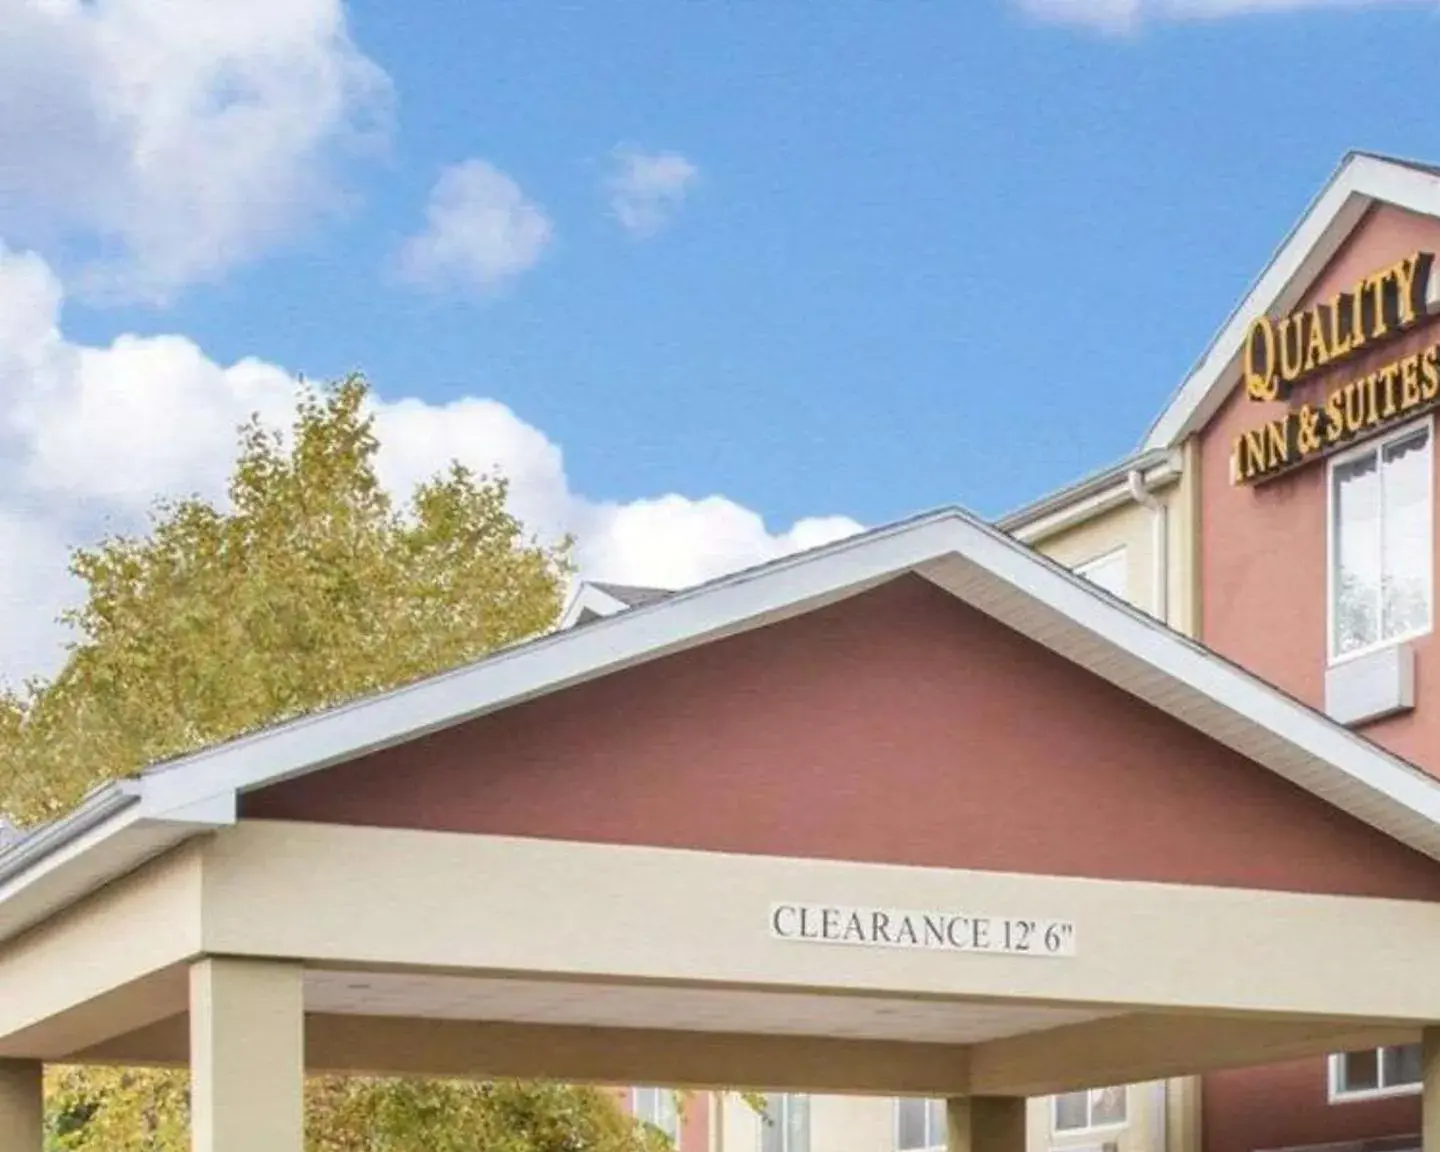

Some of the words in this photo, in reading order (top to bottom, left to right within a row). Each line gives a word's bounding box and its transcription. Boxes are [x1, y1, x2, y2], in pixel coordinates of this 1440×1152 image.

[1244, 251, 1428, 401] QUALITY
[1232, 414, 1291, 484] INN
[1297, 403, 1322, 456] &
[772, 905, 991, 949] CLEARANCE
